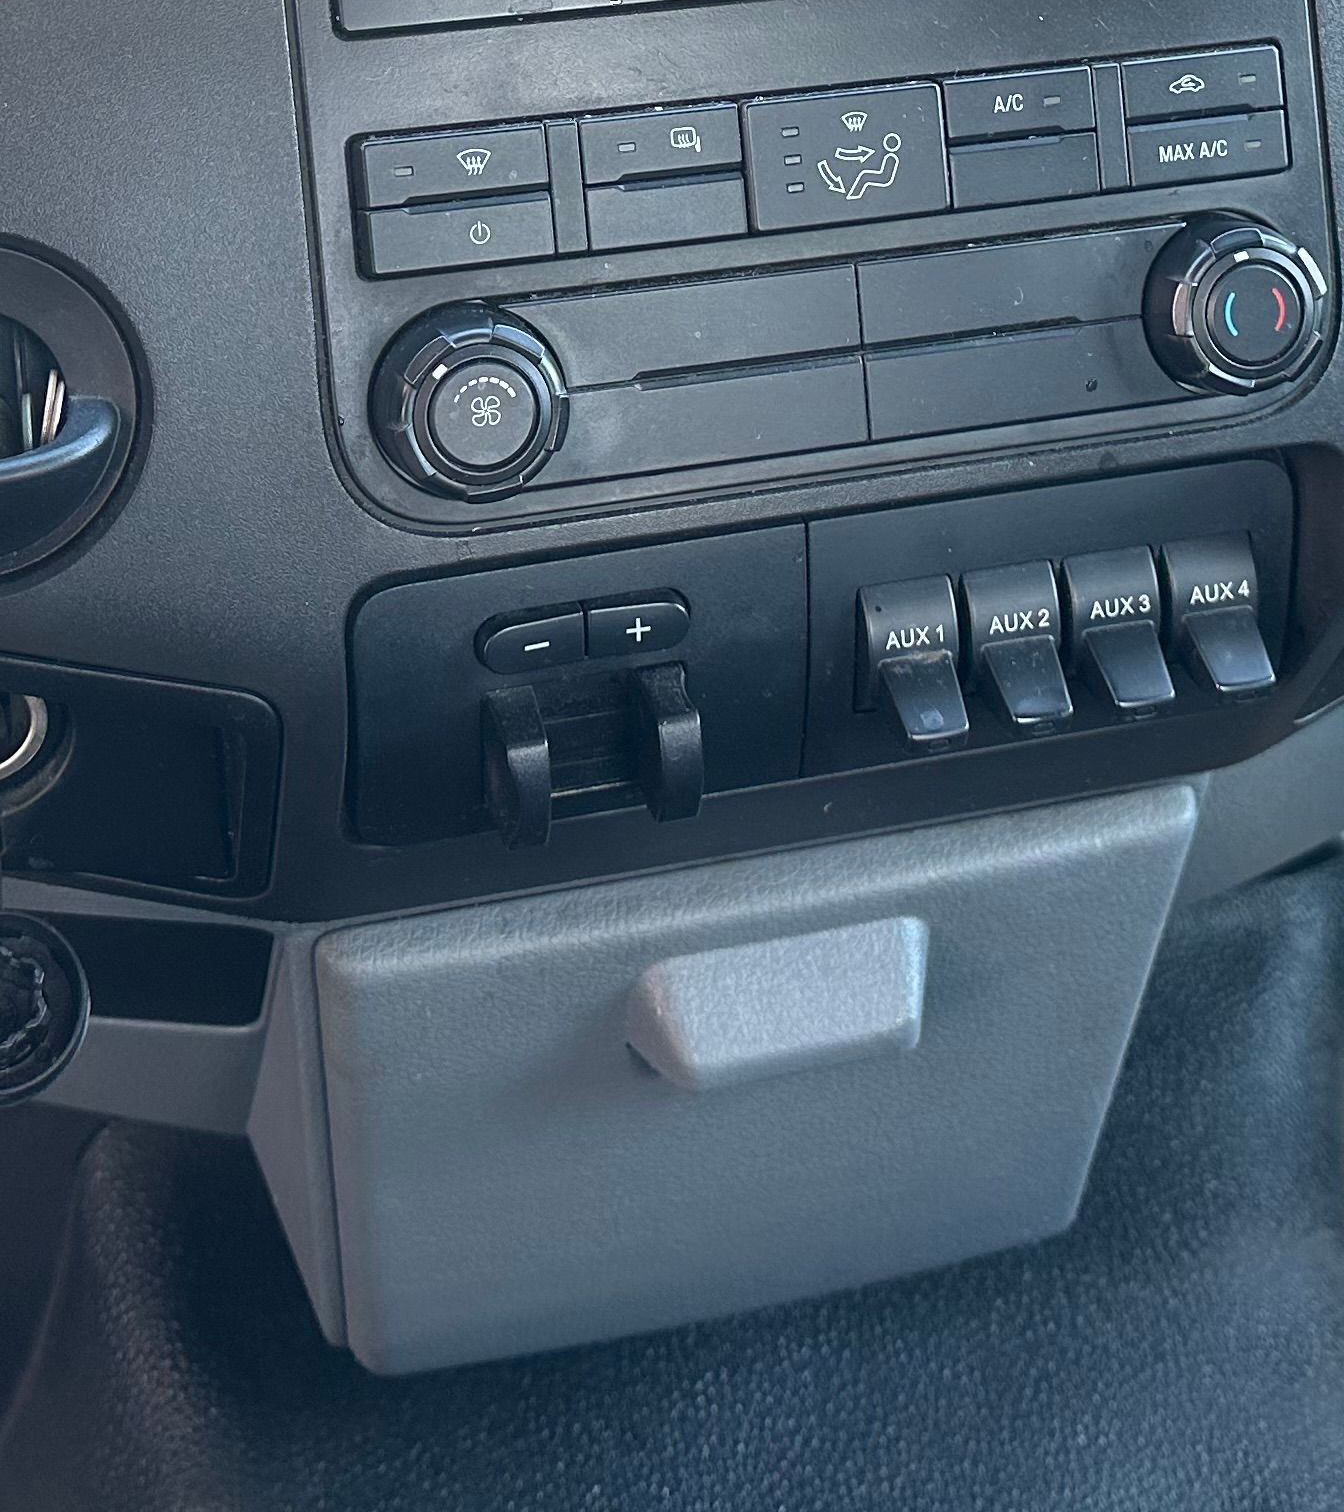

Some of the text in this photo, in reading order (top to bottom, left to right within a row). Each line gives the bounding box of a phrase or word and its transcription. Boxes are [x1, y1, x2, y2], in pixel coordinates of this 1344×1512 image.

[993, 92, 1025, 114] A/C
[1157, 139, 1229, 164] MAX A/C
[1189, 578, 1250, 605] AUX 4
[1089, 593, 1152, 621] AUX 3
[988, 608, 1050, 636] AUX 2
[885, 623, 945, 651] AUX 1
